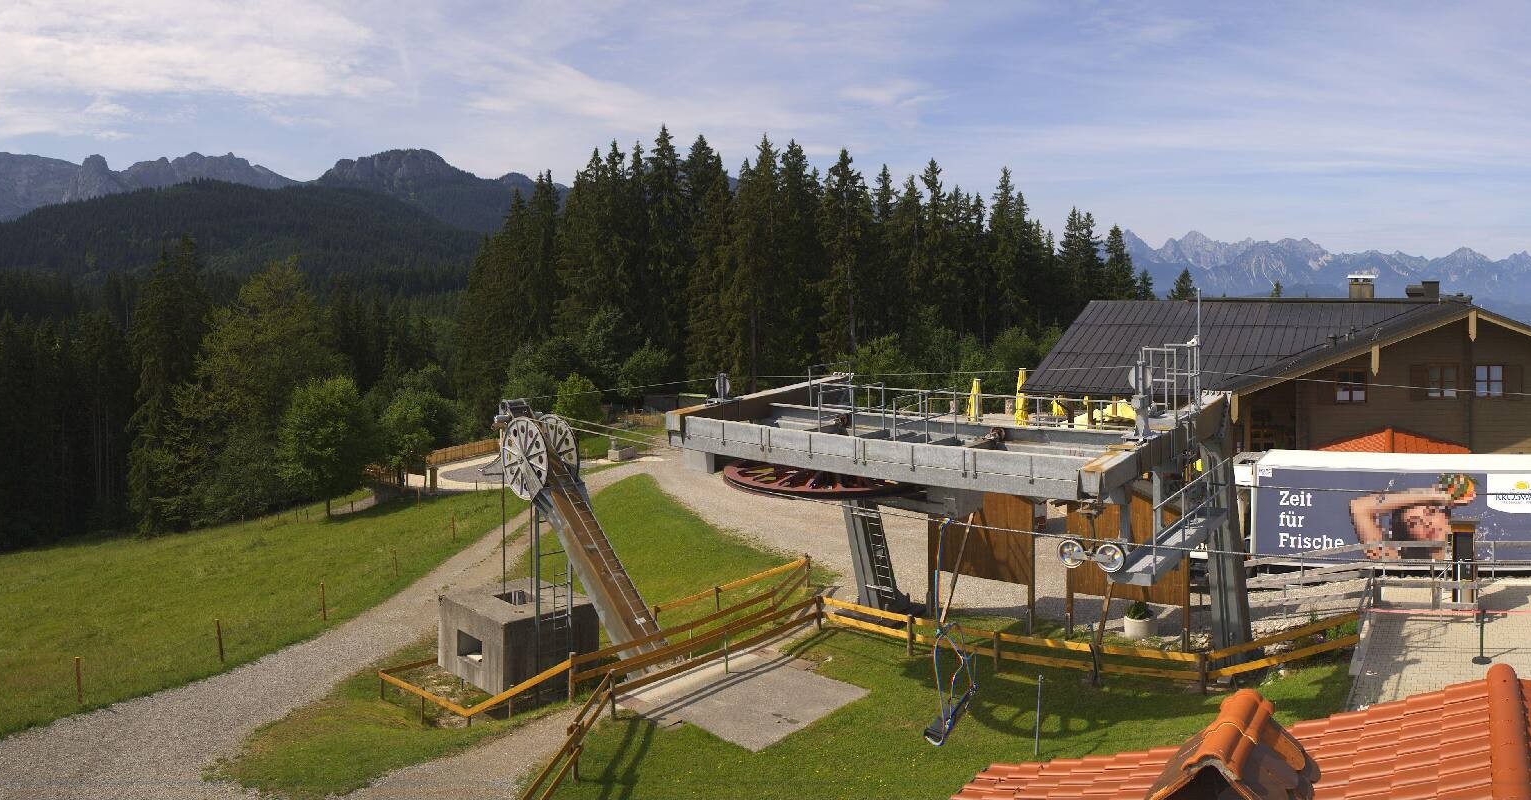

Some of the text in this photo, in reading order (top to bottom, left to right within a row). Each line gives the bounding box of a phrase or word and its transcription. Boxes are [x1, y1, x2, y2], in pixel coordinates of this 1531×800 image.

[1279, 490, 1312, 507] Zeit
[1279, 511, 1305, 528] für
[1278, 532, 1345, 549] Frische
